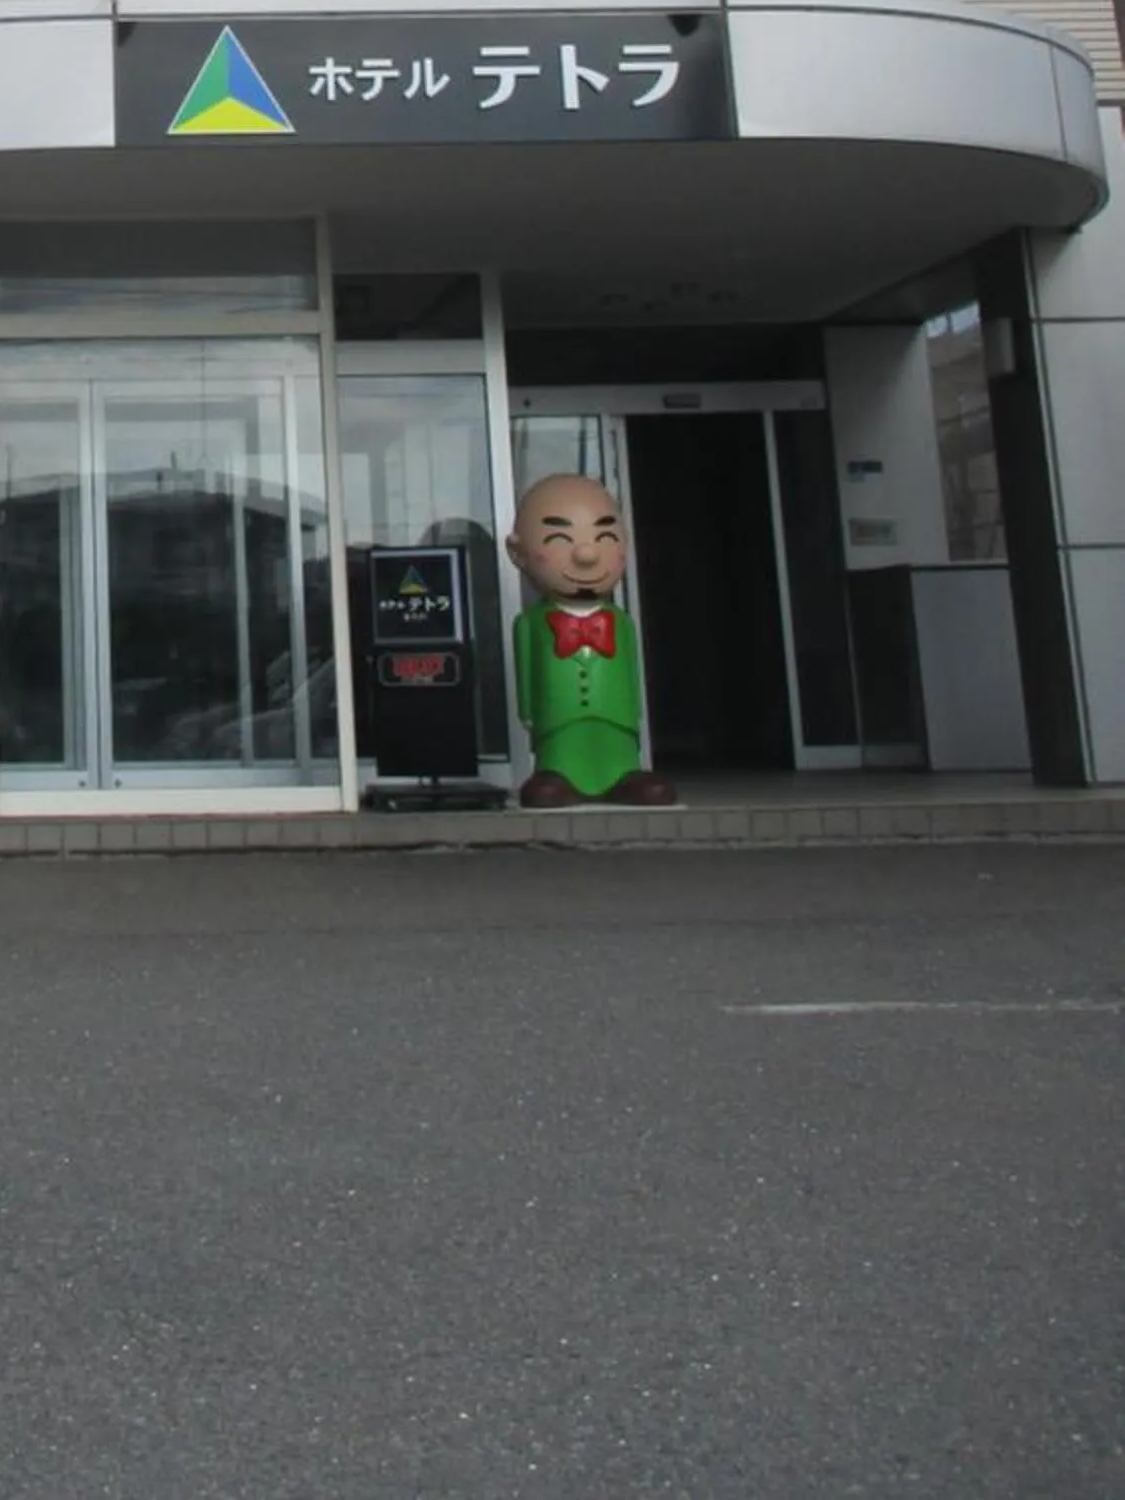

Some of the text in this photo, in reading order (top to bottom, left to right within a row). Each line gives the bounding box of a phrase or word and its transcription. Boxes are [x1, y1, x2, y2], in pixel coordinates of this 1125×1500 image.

[308, 43, 680, 110] ホテル テトラ
